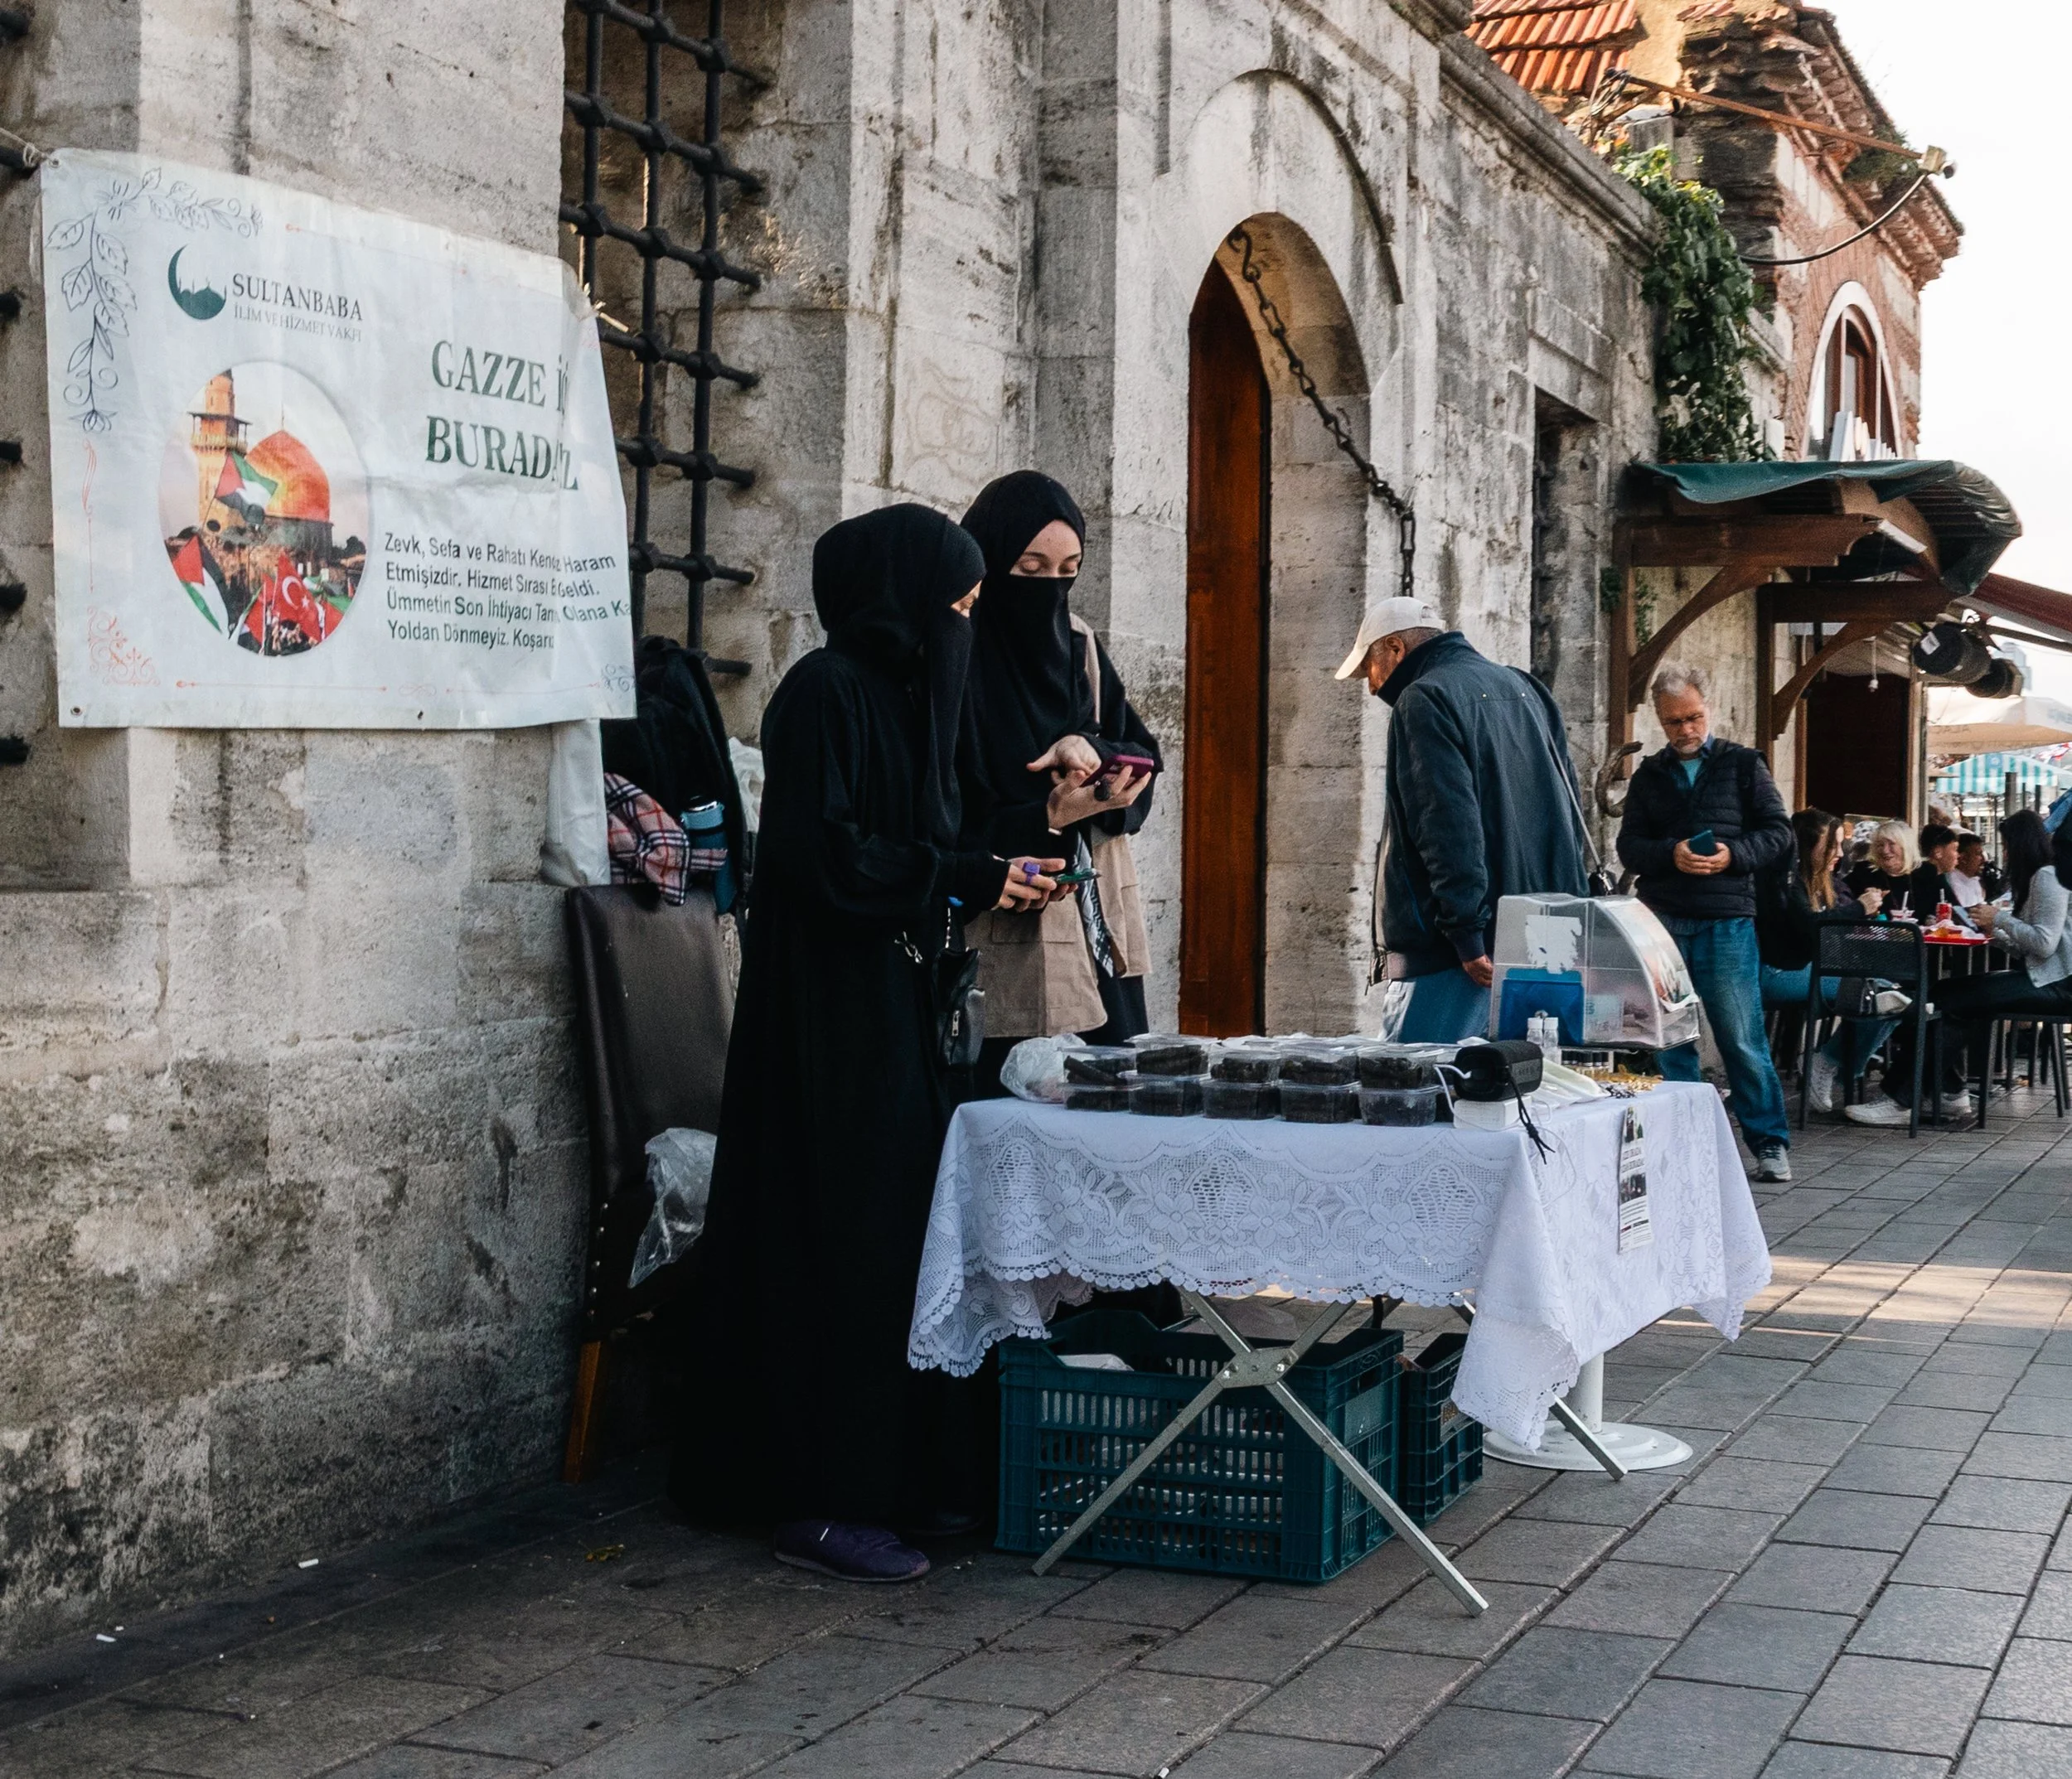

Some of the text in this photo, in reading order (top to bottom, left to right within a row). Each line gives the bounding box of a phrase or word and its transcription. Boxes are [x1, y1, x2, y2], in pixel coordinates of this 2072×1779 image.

[232, 273, 363, 321] SULTANBABA
[234, 302, 262, 323] İLİM
[265, 310, 278, 326] VE
[279, 313, 327, 336] HİZMET
[431, 340, 547, 408] GAZZE
[385, 532, 426, 558] Zevk,
[429, 537, 461, 559] Sefa
[467, 545, 482, 561] ve
[487, 544, 526, 566] Rahatı
[563, 555, 616, 573] Haram
[386, 562, 462, 585] Etmişizdir.
[467, 568, 514, 591] Hizmet
[516, 575, 549, 595] Sırası
[386, 589, 452, 615] Ümmetin
[455, 596, 483, 617] Son
[487, 594, 532, 624] İhtiyacı
[388, 620, 440, 641] Yoldan
[443, 623, 509, 650] Dönmeyiz.
